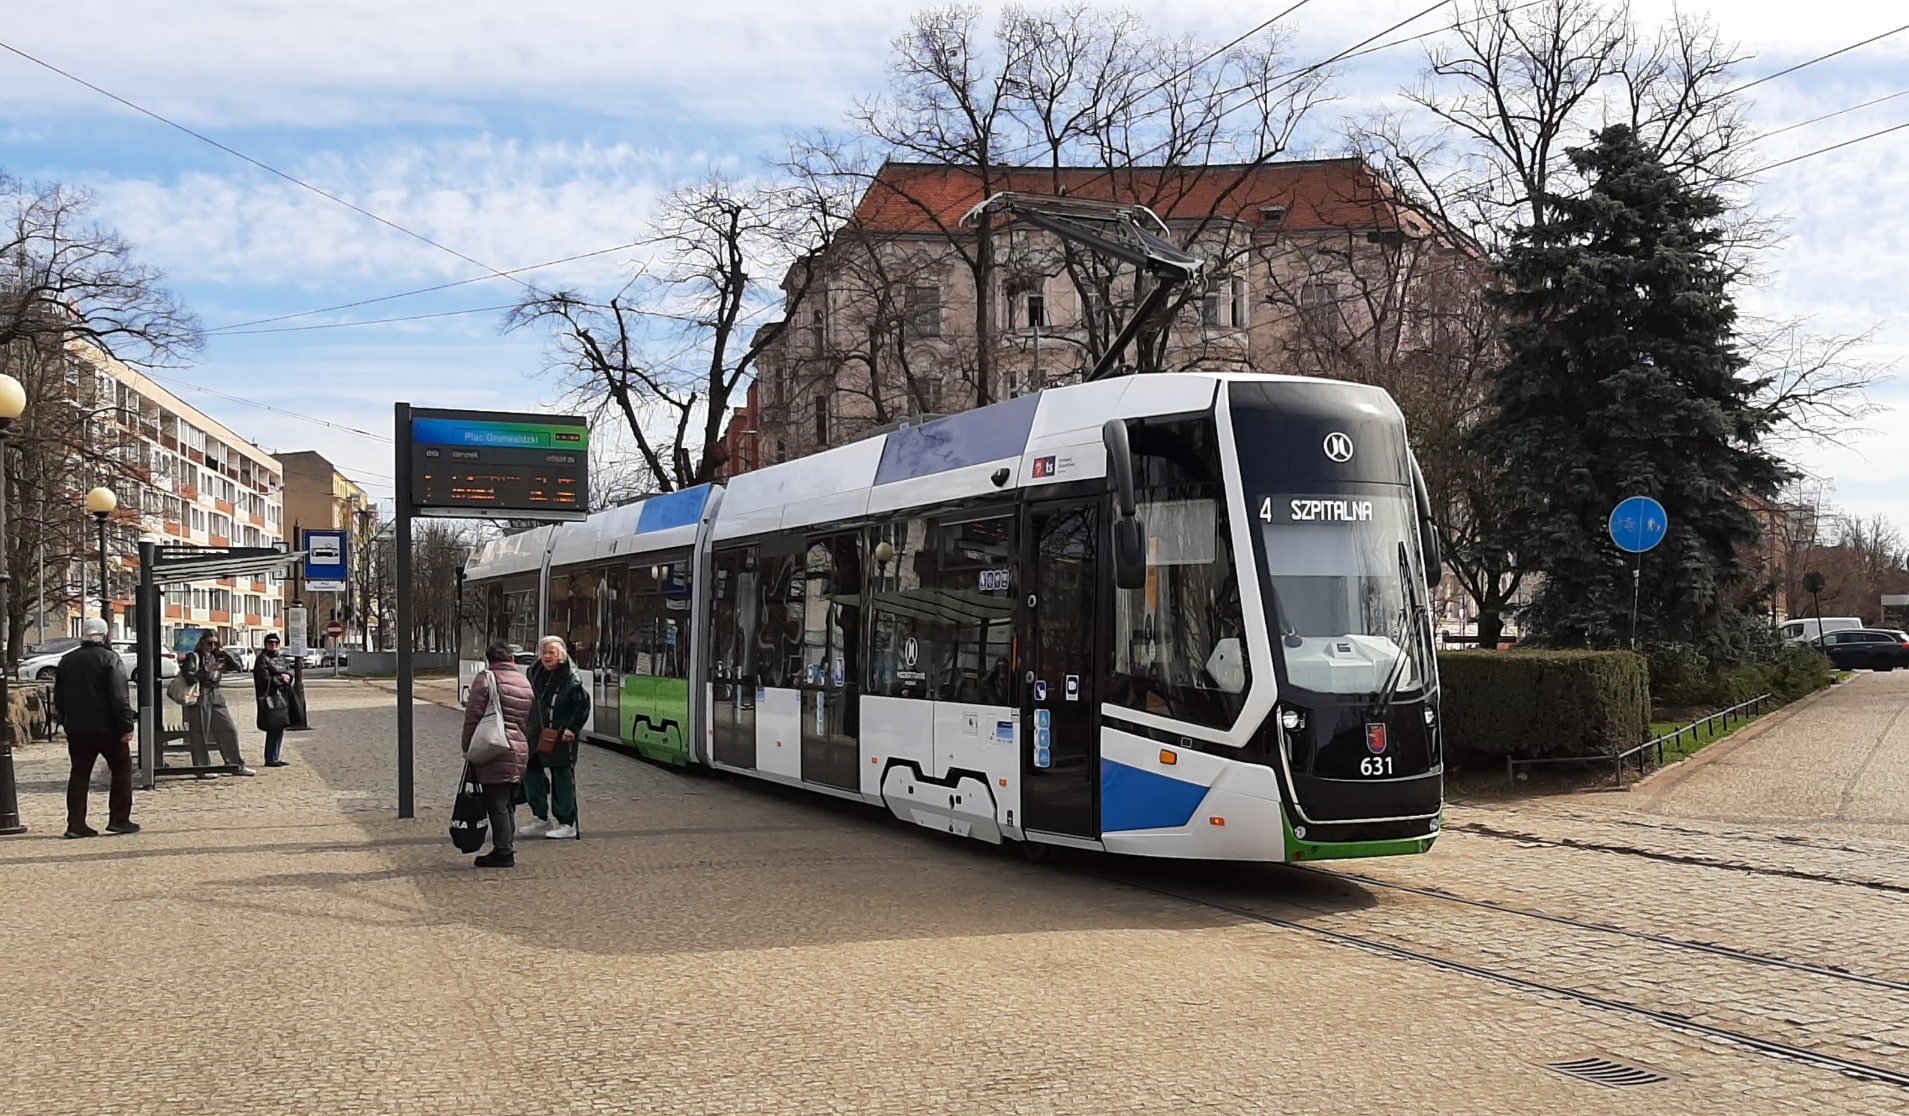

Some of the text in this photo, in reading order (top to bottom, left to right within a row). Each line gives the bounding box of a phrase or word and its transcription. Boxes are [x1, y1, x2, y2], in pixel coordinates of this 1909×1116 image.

[464, 432, 483, 442] Plac
[1259, 496, 1373, 523] 4 SZPITALNA
[1360, 756, 1393, 776] 631
